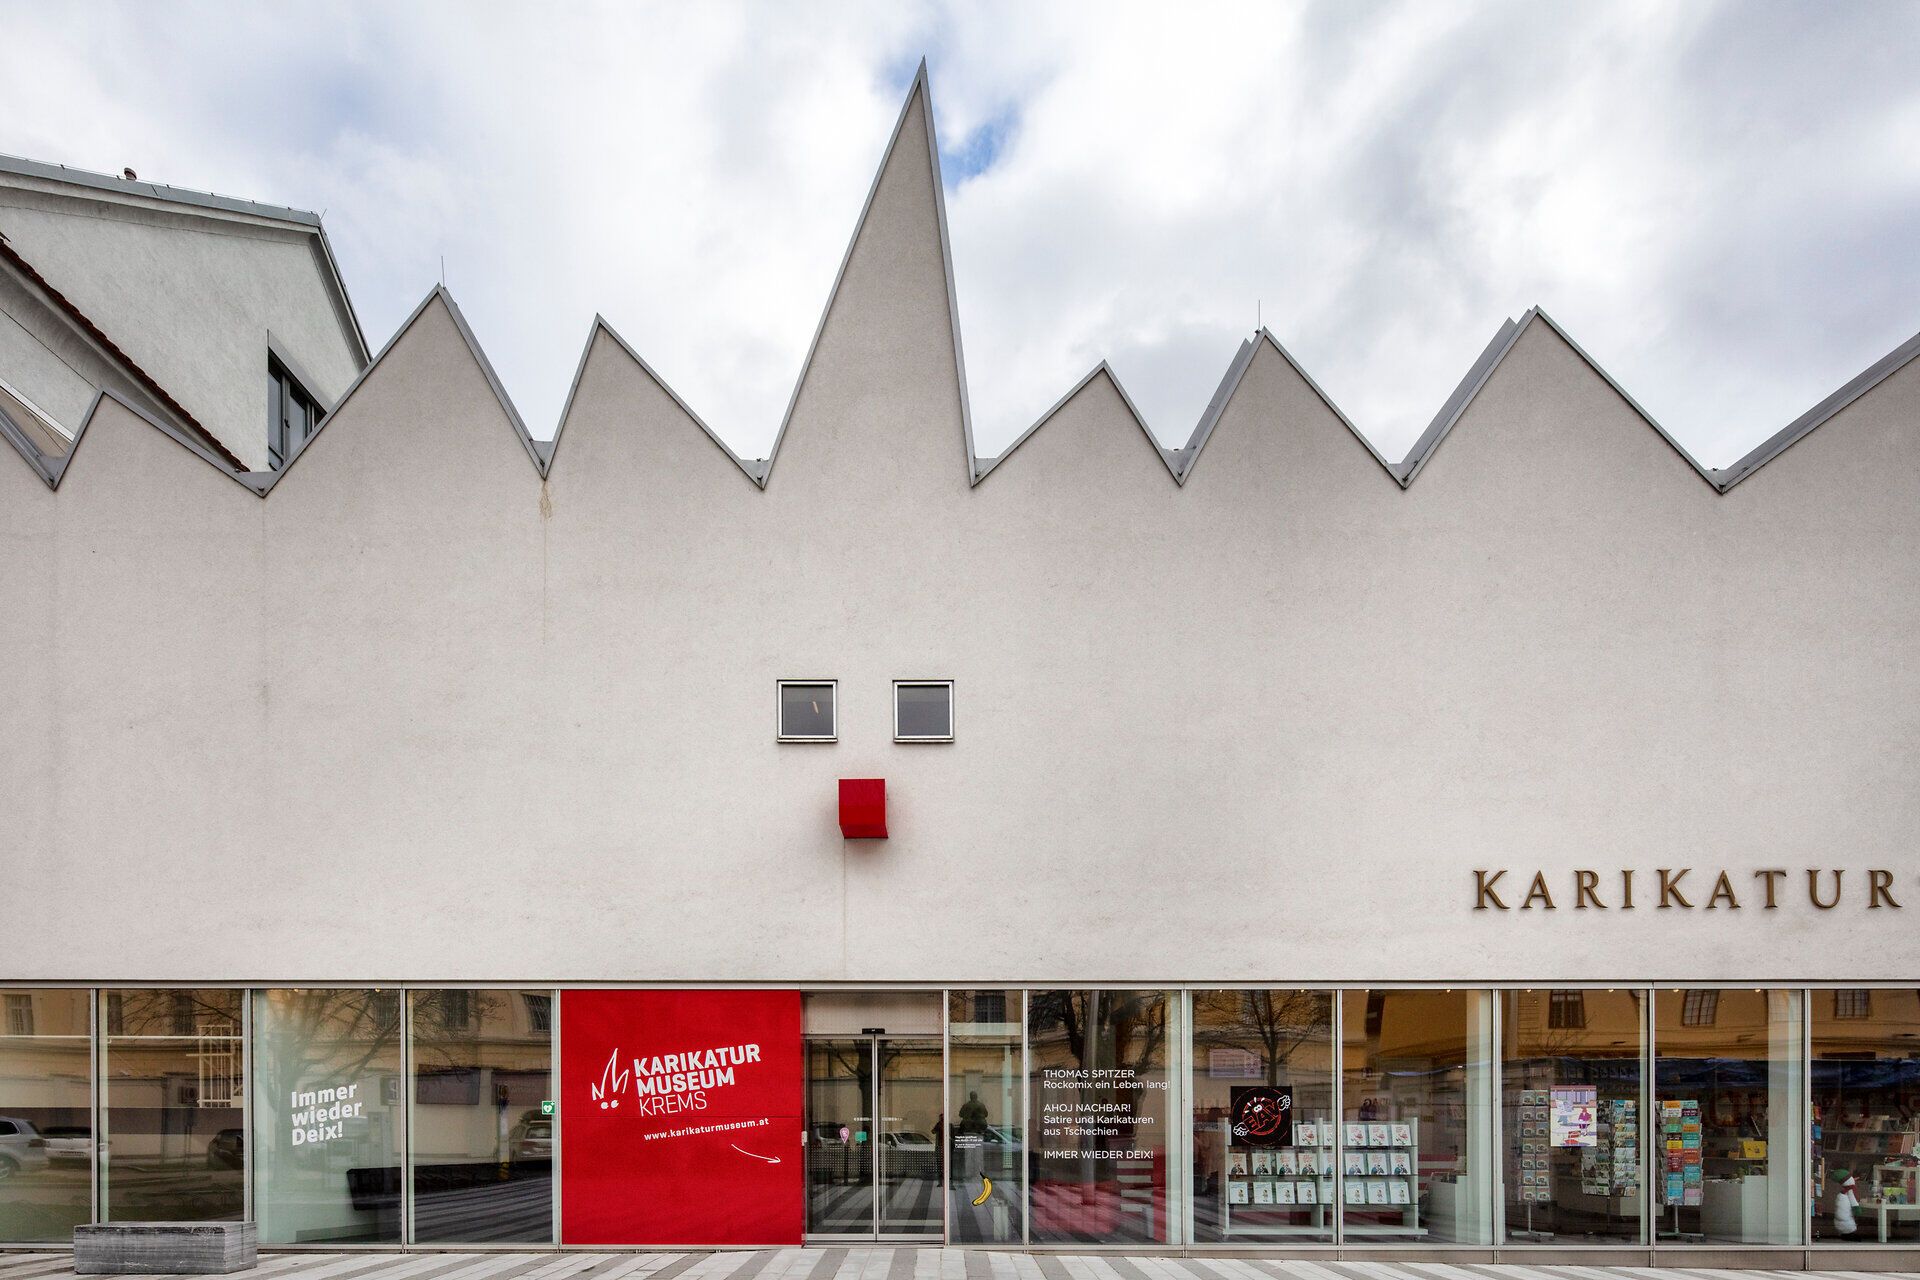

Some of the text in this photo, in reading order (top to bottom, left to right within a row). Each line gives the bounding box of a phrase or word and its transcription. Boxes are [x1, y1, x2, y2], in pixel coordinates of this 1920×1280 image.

[1472, 868, 1903, 910] KARIKATUR
[633, 1043, 762, 1078] KARIKATUR
[636, 1067, 736, 1097] MUSEUM
[1043, 1069, 1135, 1079] THOMAS SPITZER
[1043, 1080, 1171, 1090] Rockomix ein Leben lang!
[291, 1083, 358, 1108] Immer
[638, 1090, 708, 1118] KREMS
[1043, 1103, 1131, 1112] AHOJ NACHBAR!
[291, 1101, 362, 1127] wieder
[1043, 1115, 1154, 1124] Satire und Karikaturen
[291, 1121, 343, 1146] Deix!
[644, 1117, 770, 1142] www.karikaturmuseum.at
[1043, 1127, 1119, 1136] aus Tschechien
[1044, 1150, 1154, 1159] IMMER WIEDER DEIX!
